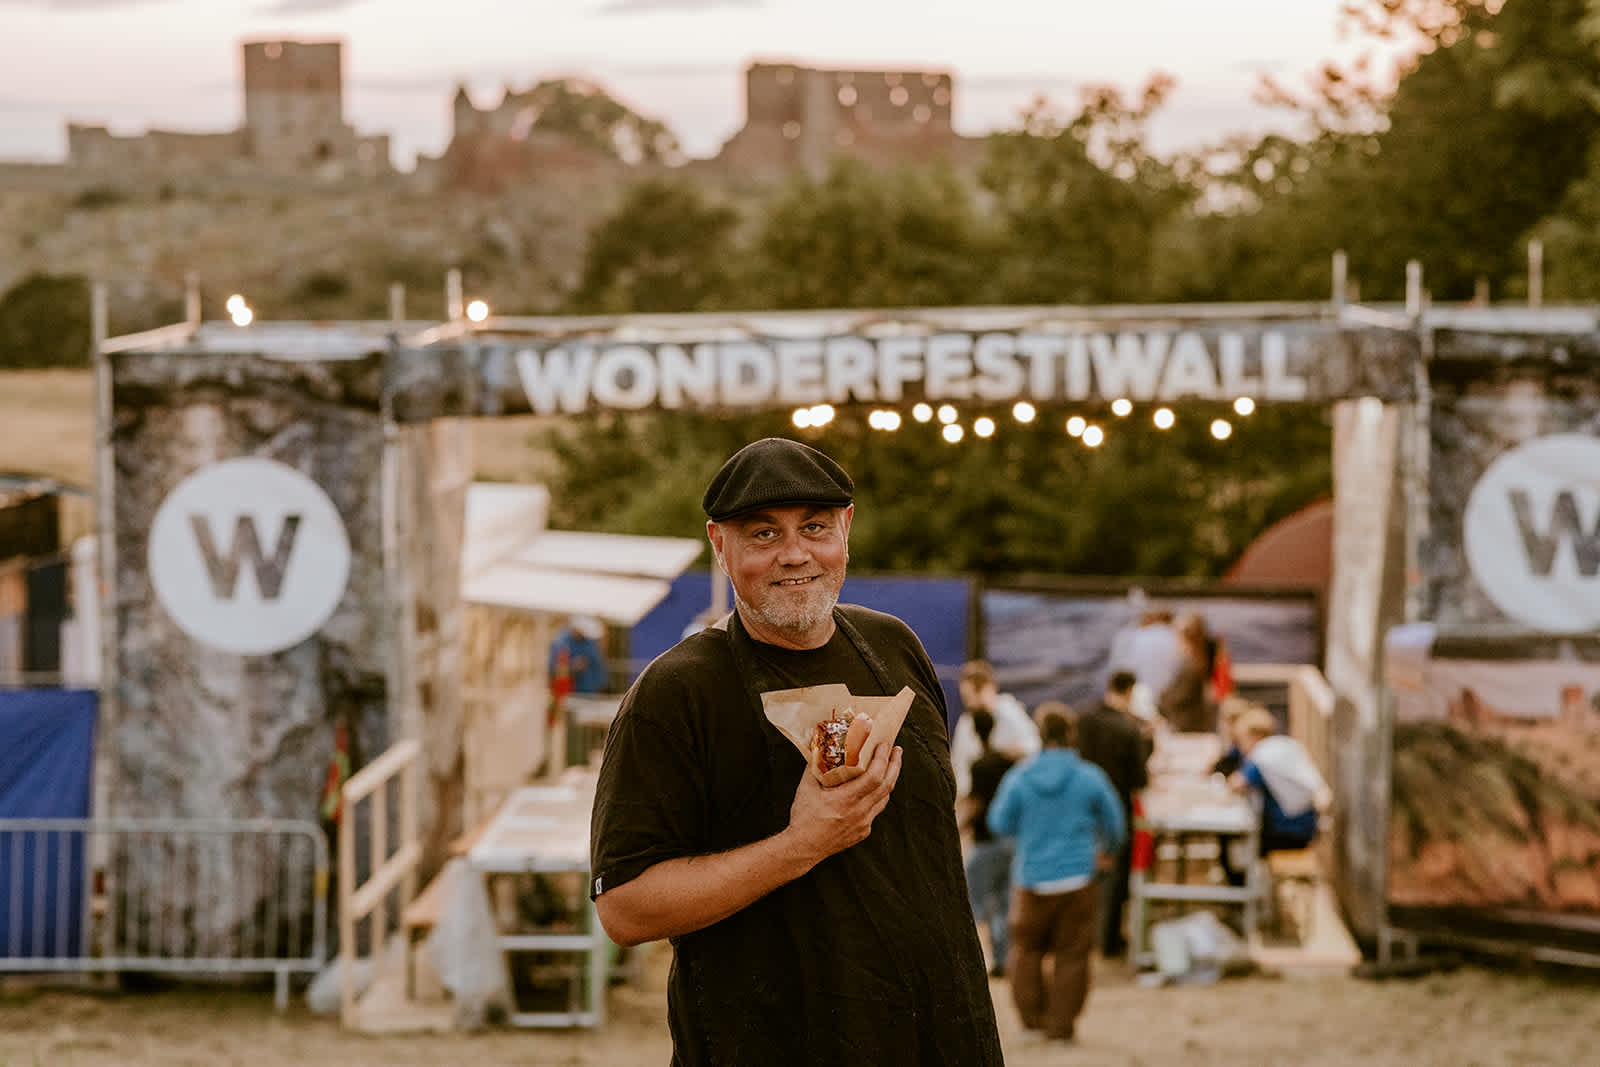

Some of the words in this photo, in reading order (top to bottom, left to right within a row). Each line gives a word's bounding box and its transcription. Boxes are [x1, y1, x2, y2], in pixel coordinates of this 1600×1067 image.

[516, 332, 1305, 412] WONDERFESTIWALL
[188, 514, 302, 602] W
[1506, 490, 1600, 577] W
